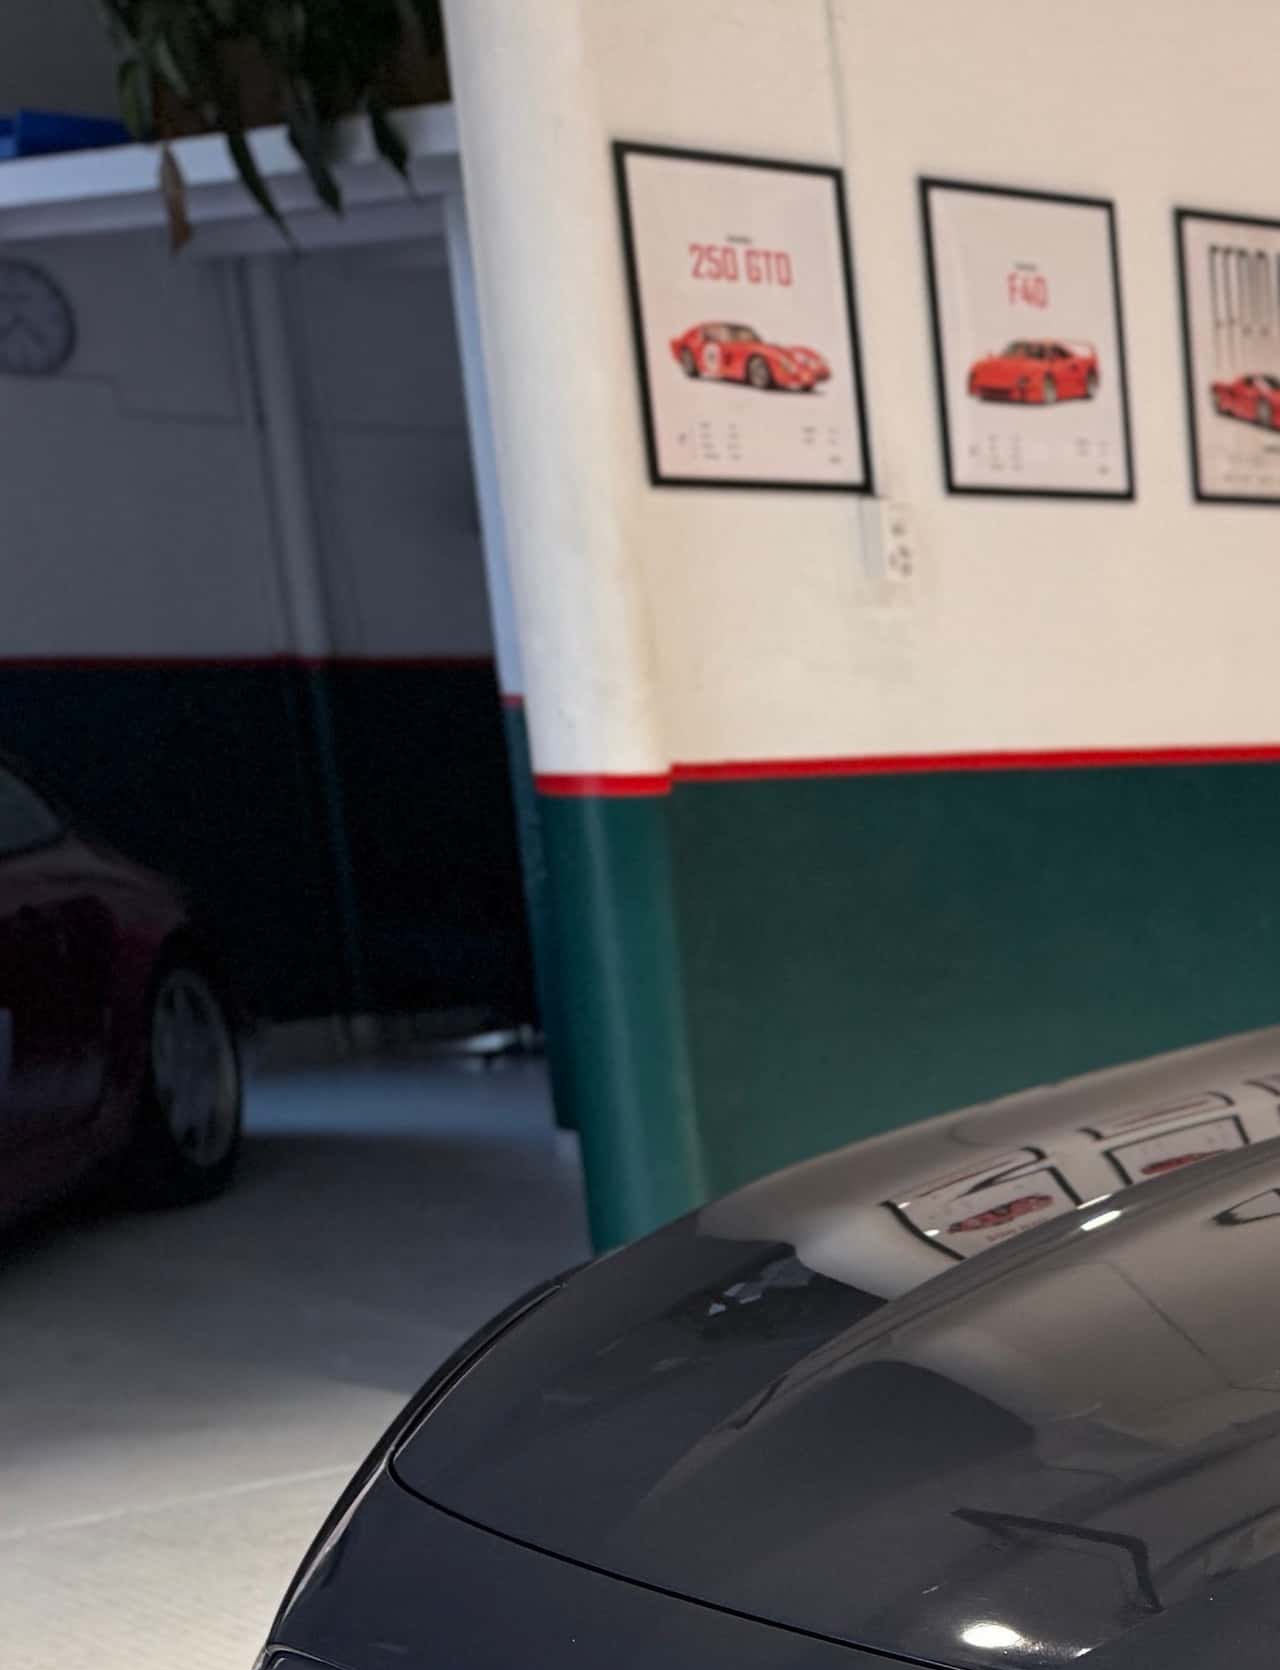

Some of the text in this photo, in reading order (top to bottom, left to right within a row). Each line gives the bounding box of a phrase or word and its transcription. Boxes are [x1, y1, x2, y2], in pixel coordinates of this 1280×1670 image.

[688, 242, 792, 287] 250 GTO
[1006, 270, 1049, 309] F40
